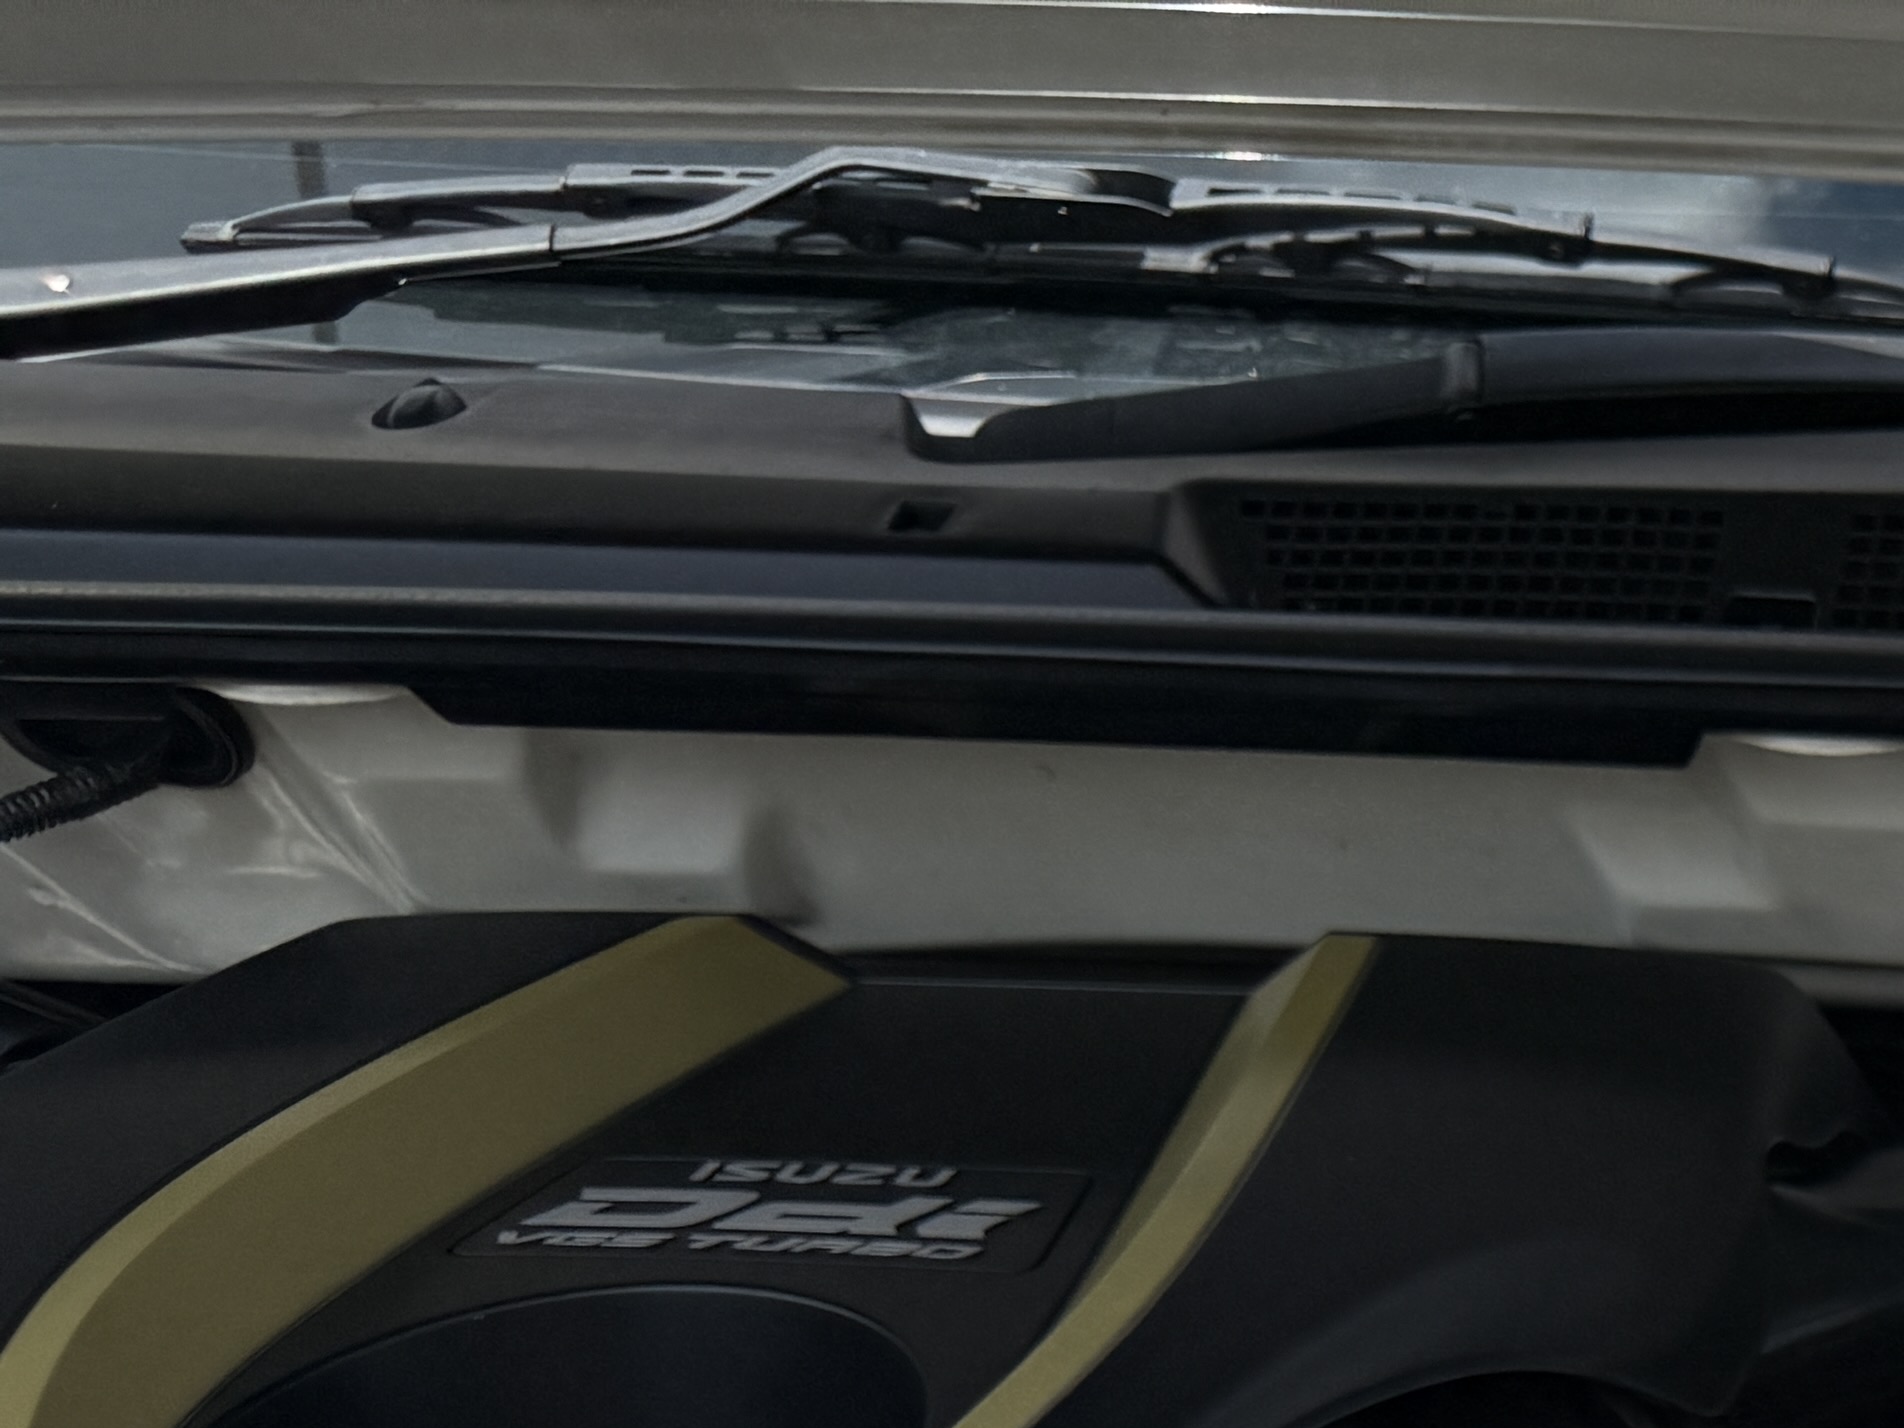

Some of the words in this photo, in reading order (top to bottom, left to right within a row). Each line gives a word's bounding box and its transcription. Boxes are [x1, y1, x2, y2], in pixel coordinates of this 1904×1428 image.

[689, 1158, 958, 1188] ISUZU
[498, 1229, 677, 1249] VGS
[689, 1232, 985, 1261] TURBO
